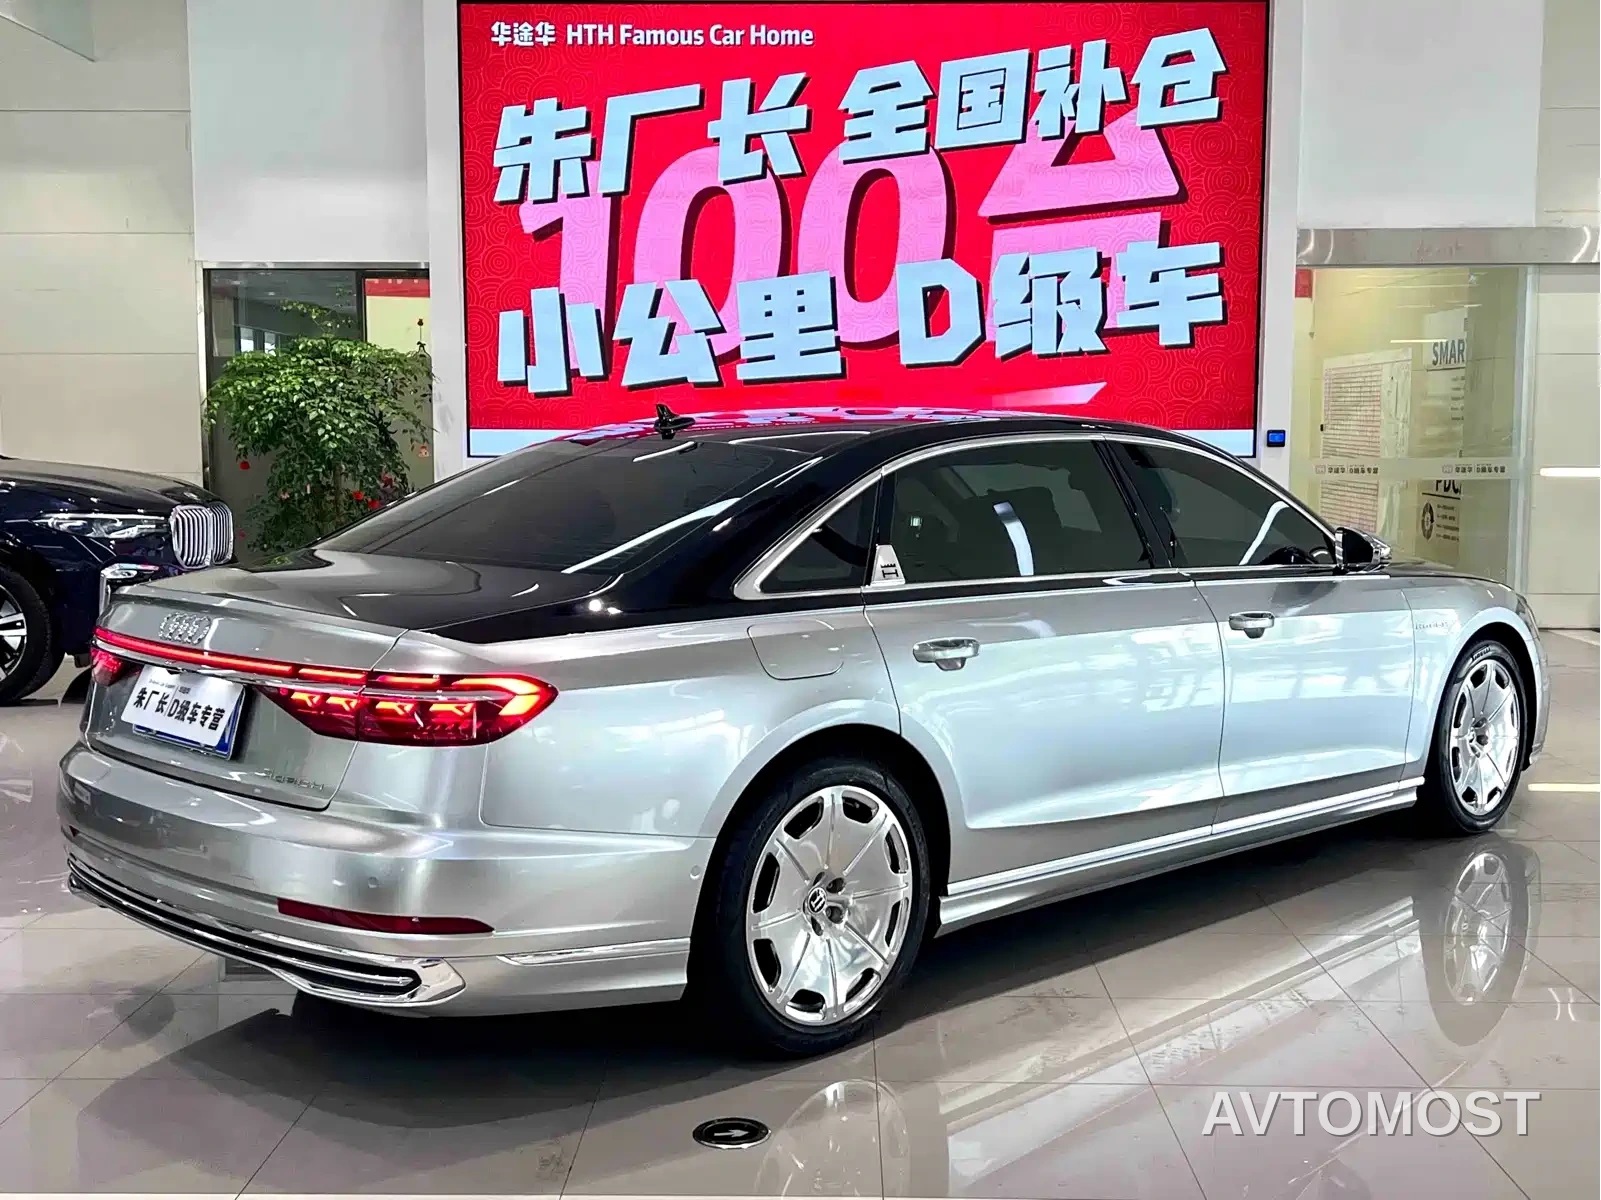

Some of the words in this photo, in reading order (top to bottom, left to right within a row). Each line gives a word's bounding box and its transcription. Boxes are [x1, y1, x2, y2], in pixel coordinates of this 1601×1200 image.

[491, 21, 556, 46] 华途华
[566, 24, 614, 45] HTH
[620, 24, 704, 45] Famous
[709, 24, 745, 45] Car
[750, 24, 814, 45] Home
[493, 72, 810, 203] 朱厂长
[837, 28, 1226, 163] 全国补仓
[497, 271, 846, 394] 小公里
[897, 241, 1225, 366] D级车
[133, 687, 170, 714] 朱厂长
[167, 698, 226, 731] D级车专营
